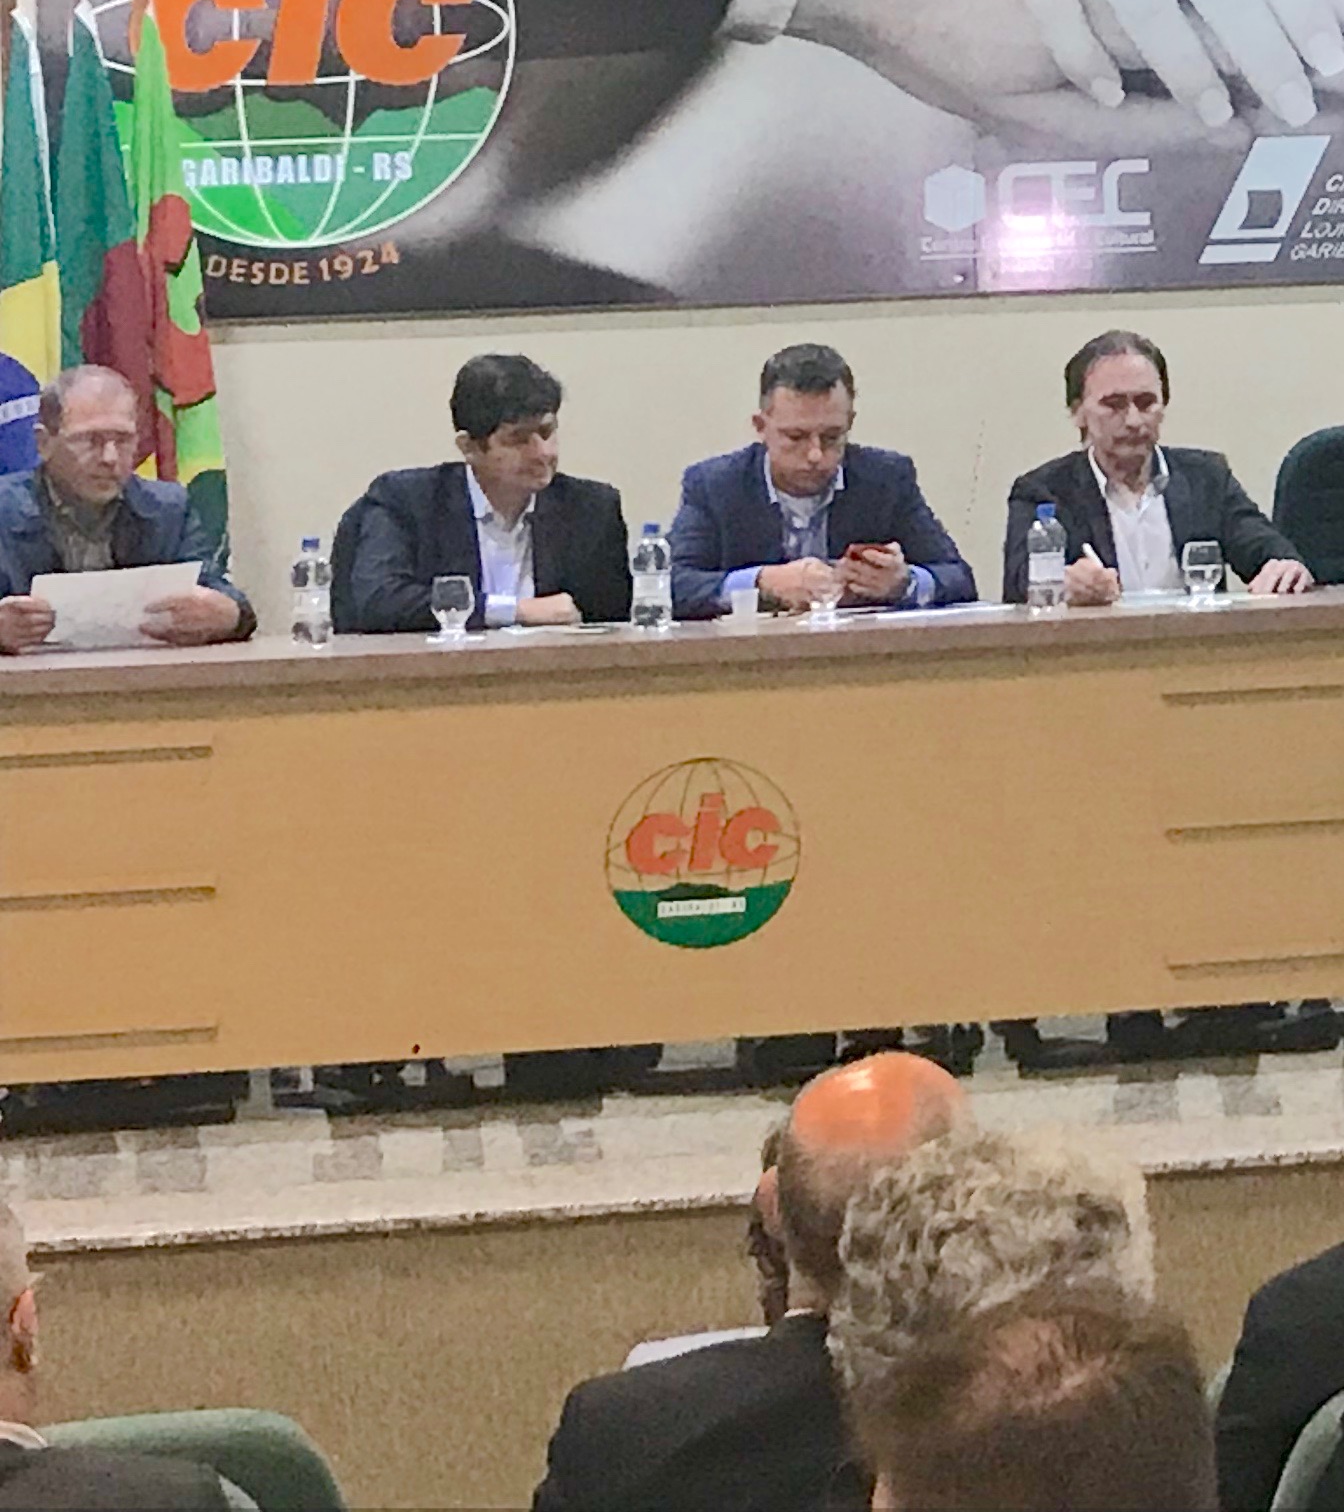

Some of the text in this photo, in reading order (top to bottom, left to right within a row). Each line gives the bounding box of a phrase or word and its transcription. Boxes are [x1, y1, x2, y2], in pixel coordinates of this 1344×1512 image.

[182, 152, 347, 188] GARIBALDI
[372, 150, 414, 181] RS
[205, 240, 399, 285] DESDE 1924
